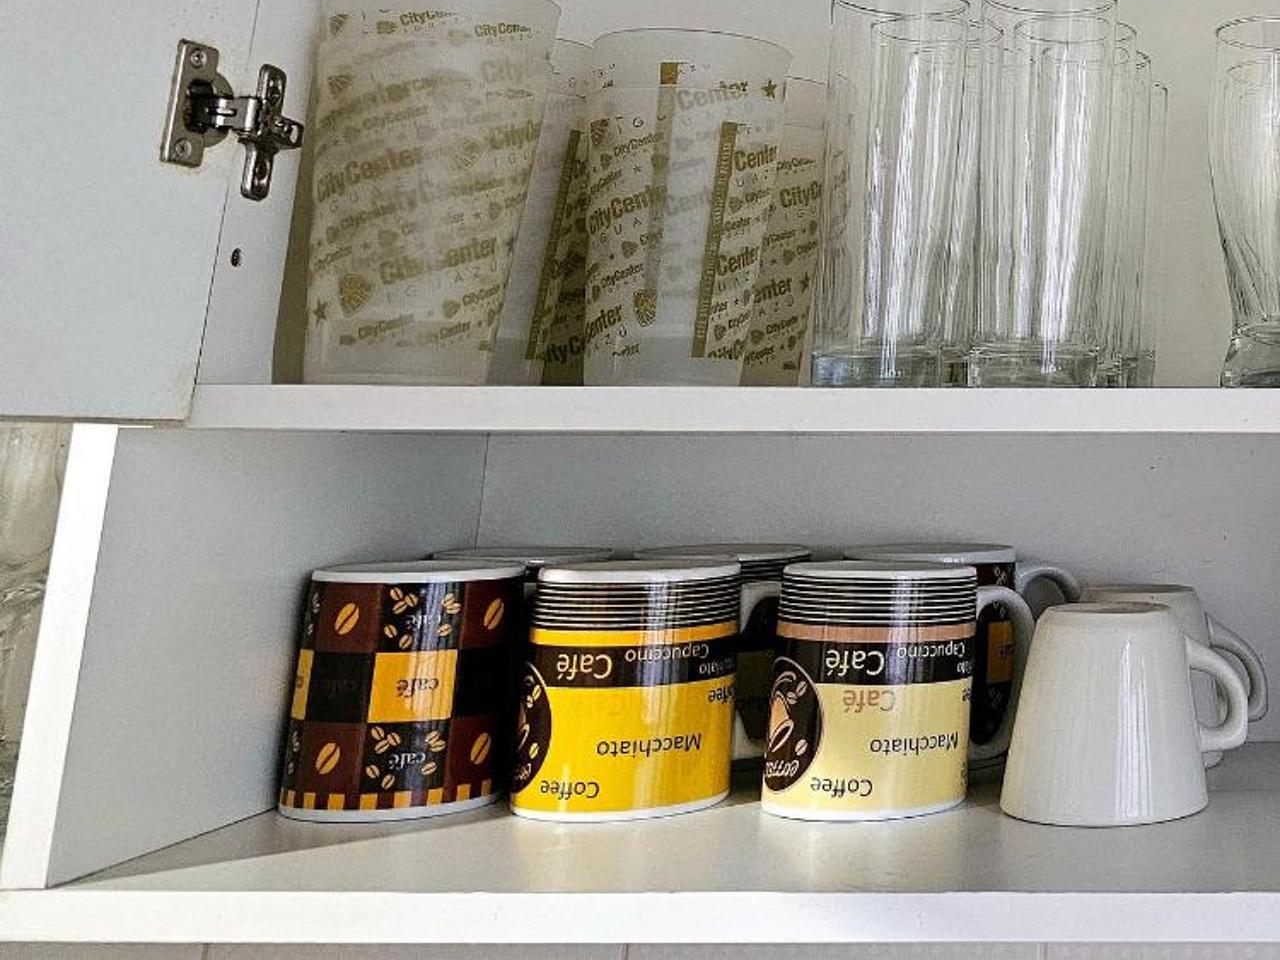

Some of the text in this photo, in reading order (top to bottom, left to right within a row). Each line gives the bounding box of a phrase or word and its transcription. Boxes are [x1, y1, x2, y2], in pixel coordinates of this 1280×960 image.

[624, 643, 710, 664] Capuccino
[897, 641, 966, 659] Capuccino
[556, 653, 613, 680] Café
[825, 649, 885, 677] Café
[842, 689, 896, 713] Café
[597, 732, 702, 757] Macchiato
[869, 731, 958, 756] Macchiato
[540, 779, 600, 800] Coffee
[810, 776, 873, 798] Coffee
